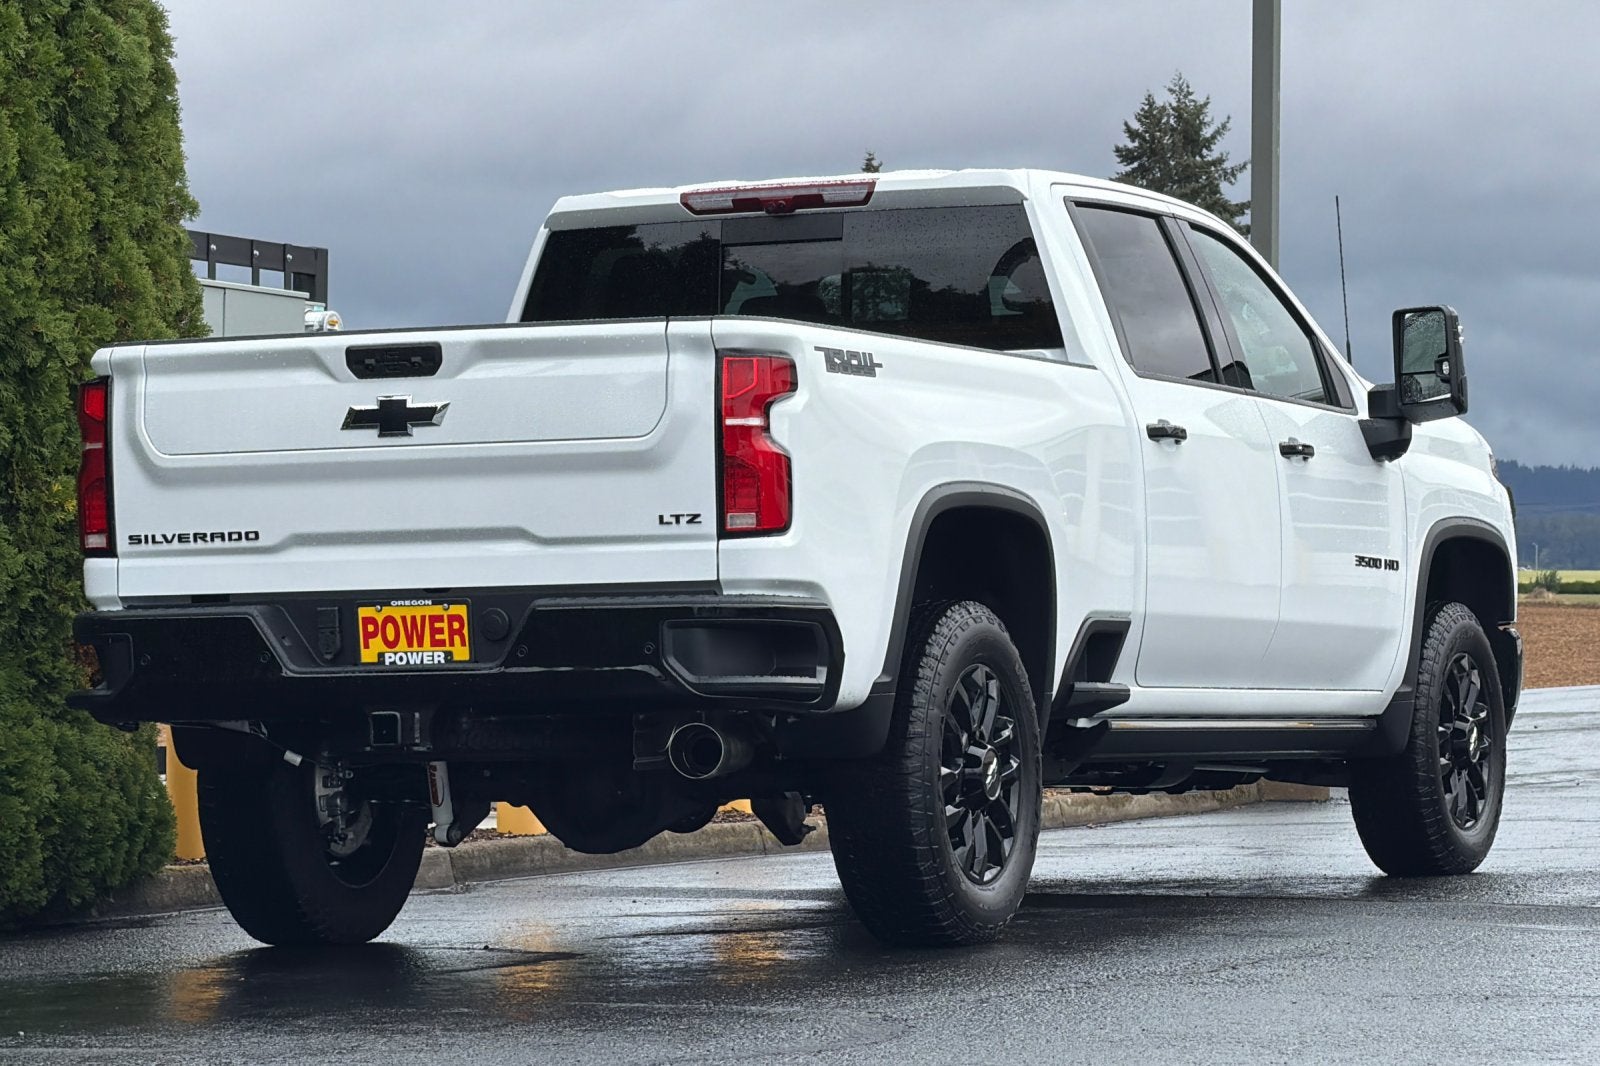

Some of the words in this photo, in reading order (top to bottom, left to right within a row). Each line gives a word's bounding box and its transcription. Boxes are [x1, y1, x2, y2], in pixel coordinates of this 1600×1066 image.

[658, 513, 702, 525] LTZ
[128, 530, 260, 545] SILVERADO
[1355, 555, 1382, 570] 3500
[1384, 558, 1399, 571] HD
[361, 614, 467, 649] POWER
[384, 651, 445, 665] POWER
